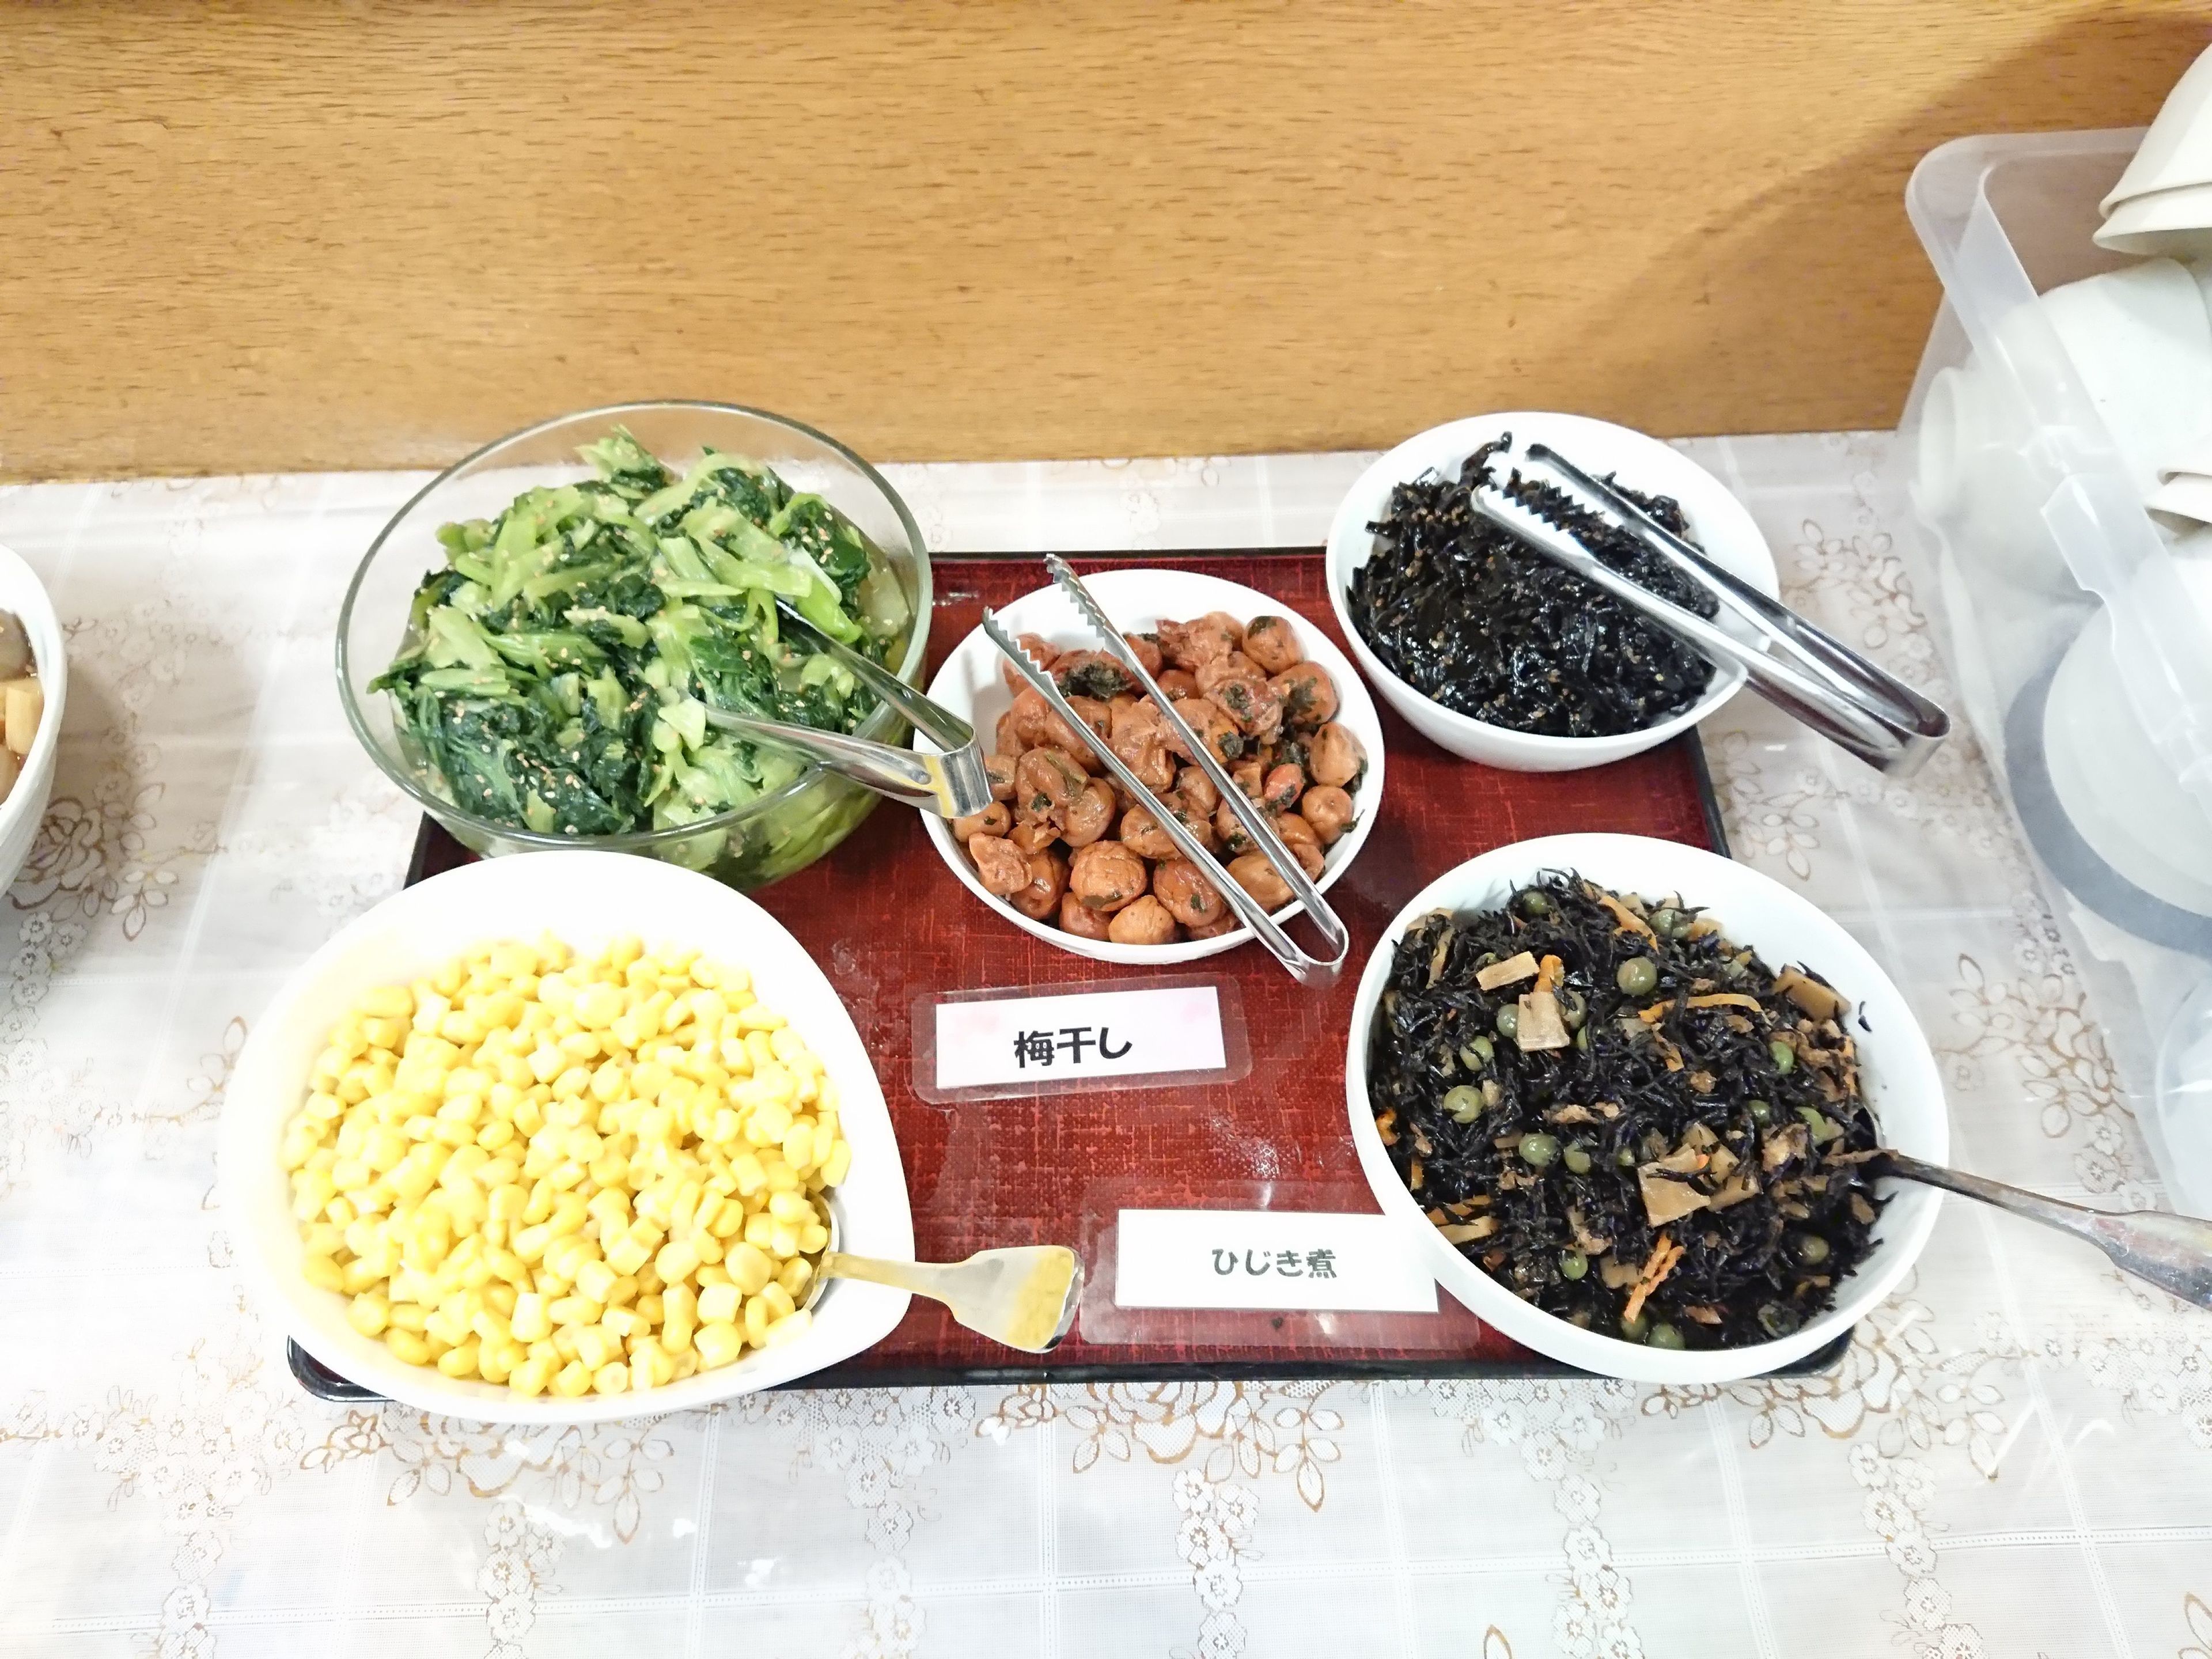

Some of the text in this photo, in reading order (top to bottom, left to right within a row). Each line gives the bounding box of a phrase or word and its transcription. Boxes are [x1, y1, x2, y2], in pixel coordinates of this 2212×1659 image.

[1013, 1027, 1132, 1069] 梅干し
[1211, 1248, 1337, 1279] ひじき煮
